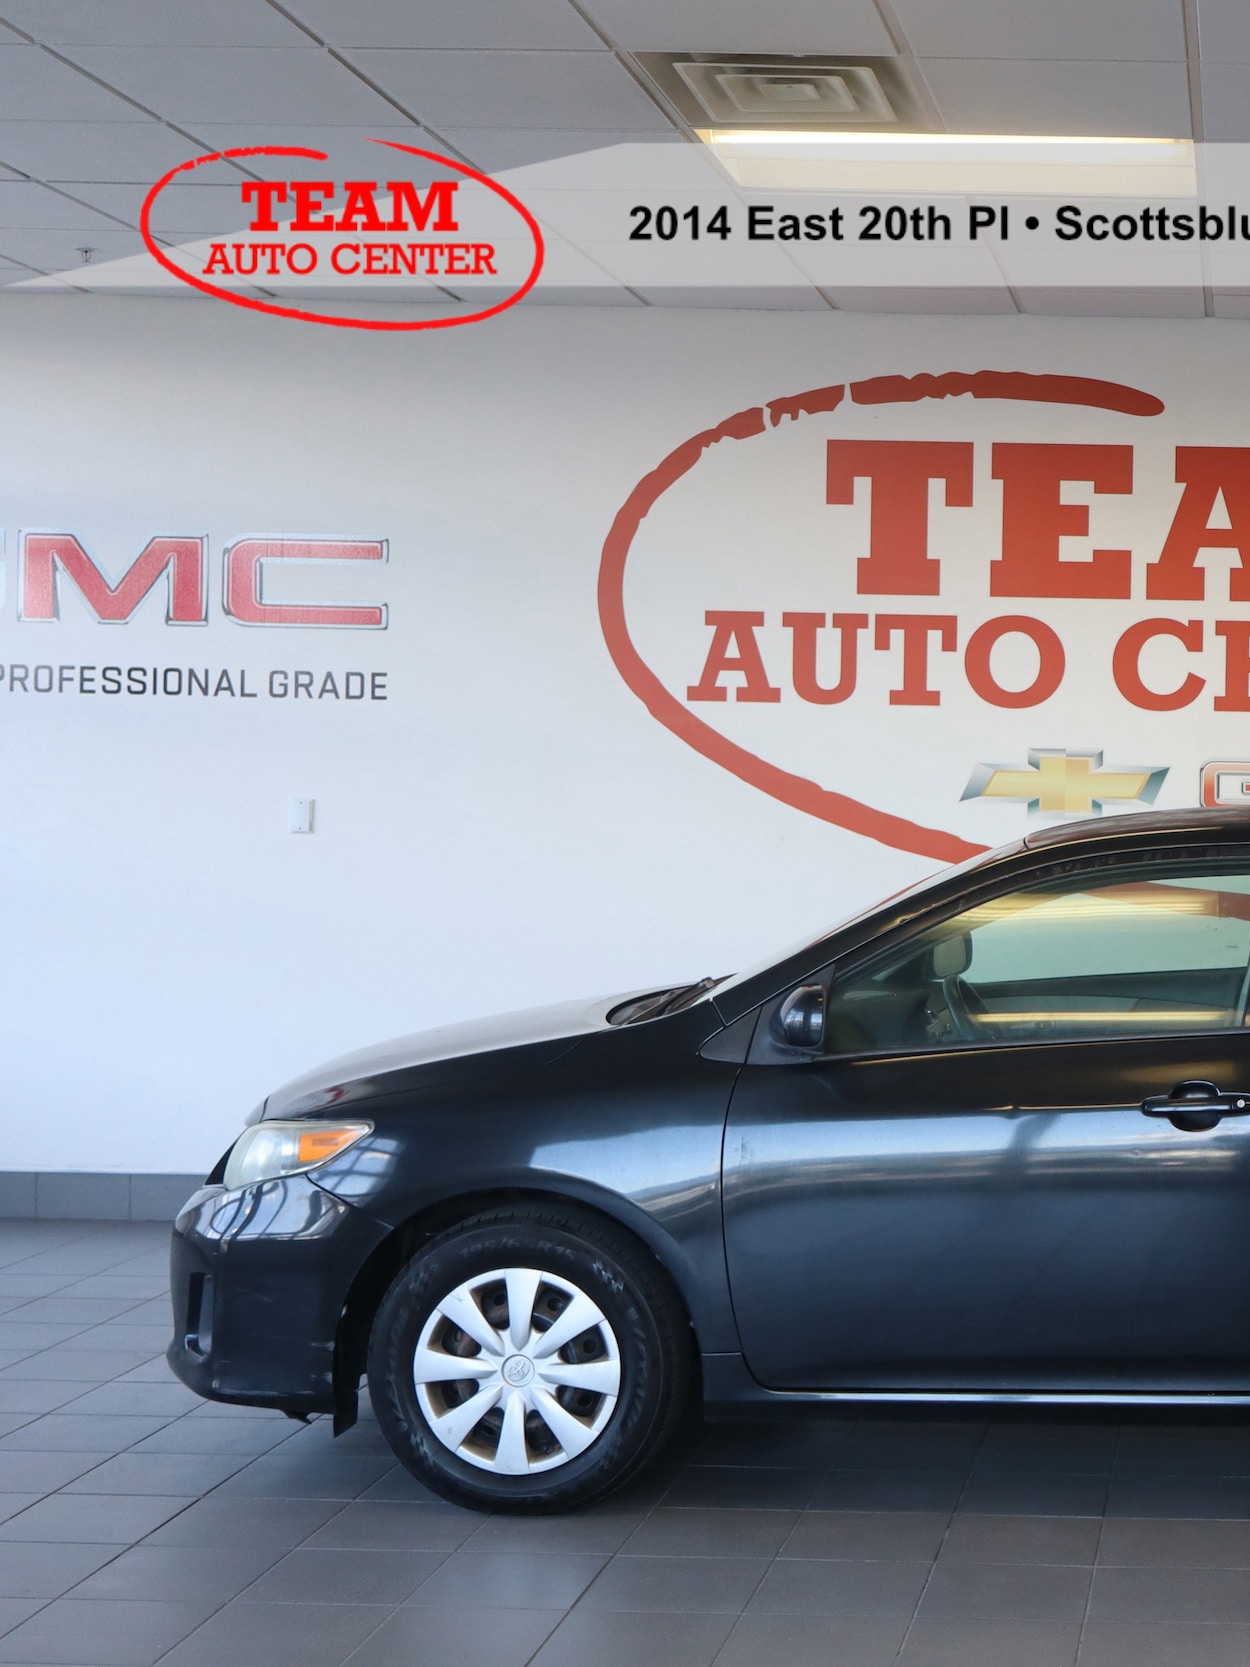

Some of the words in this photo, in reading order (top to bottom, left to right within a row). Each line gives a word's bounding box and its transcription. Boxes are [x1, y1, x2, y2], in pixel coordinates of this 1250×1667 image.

[0, 527, 389, 630] MC
[269, 670, 389, 700] GRADE
[686, 610, 1067, 711] AUTO
